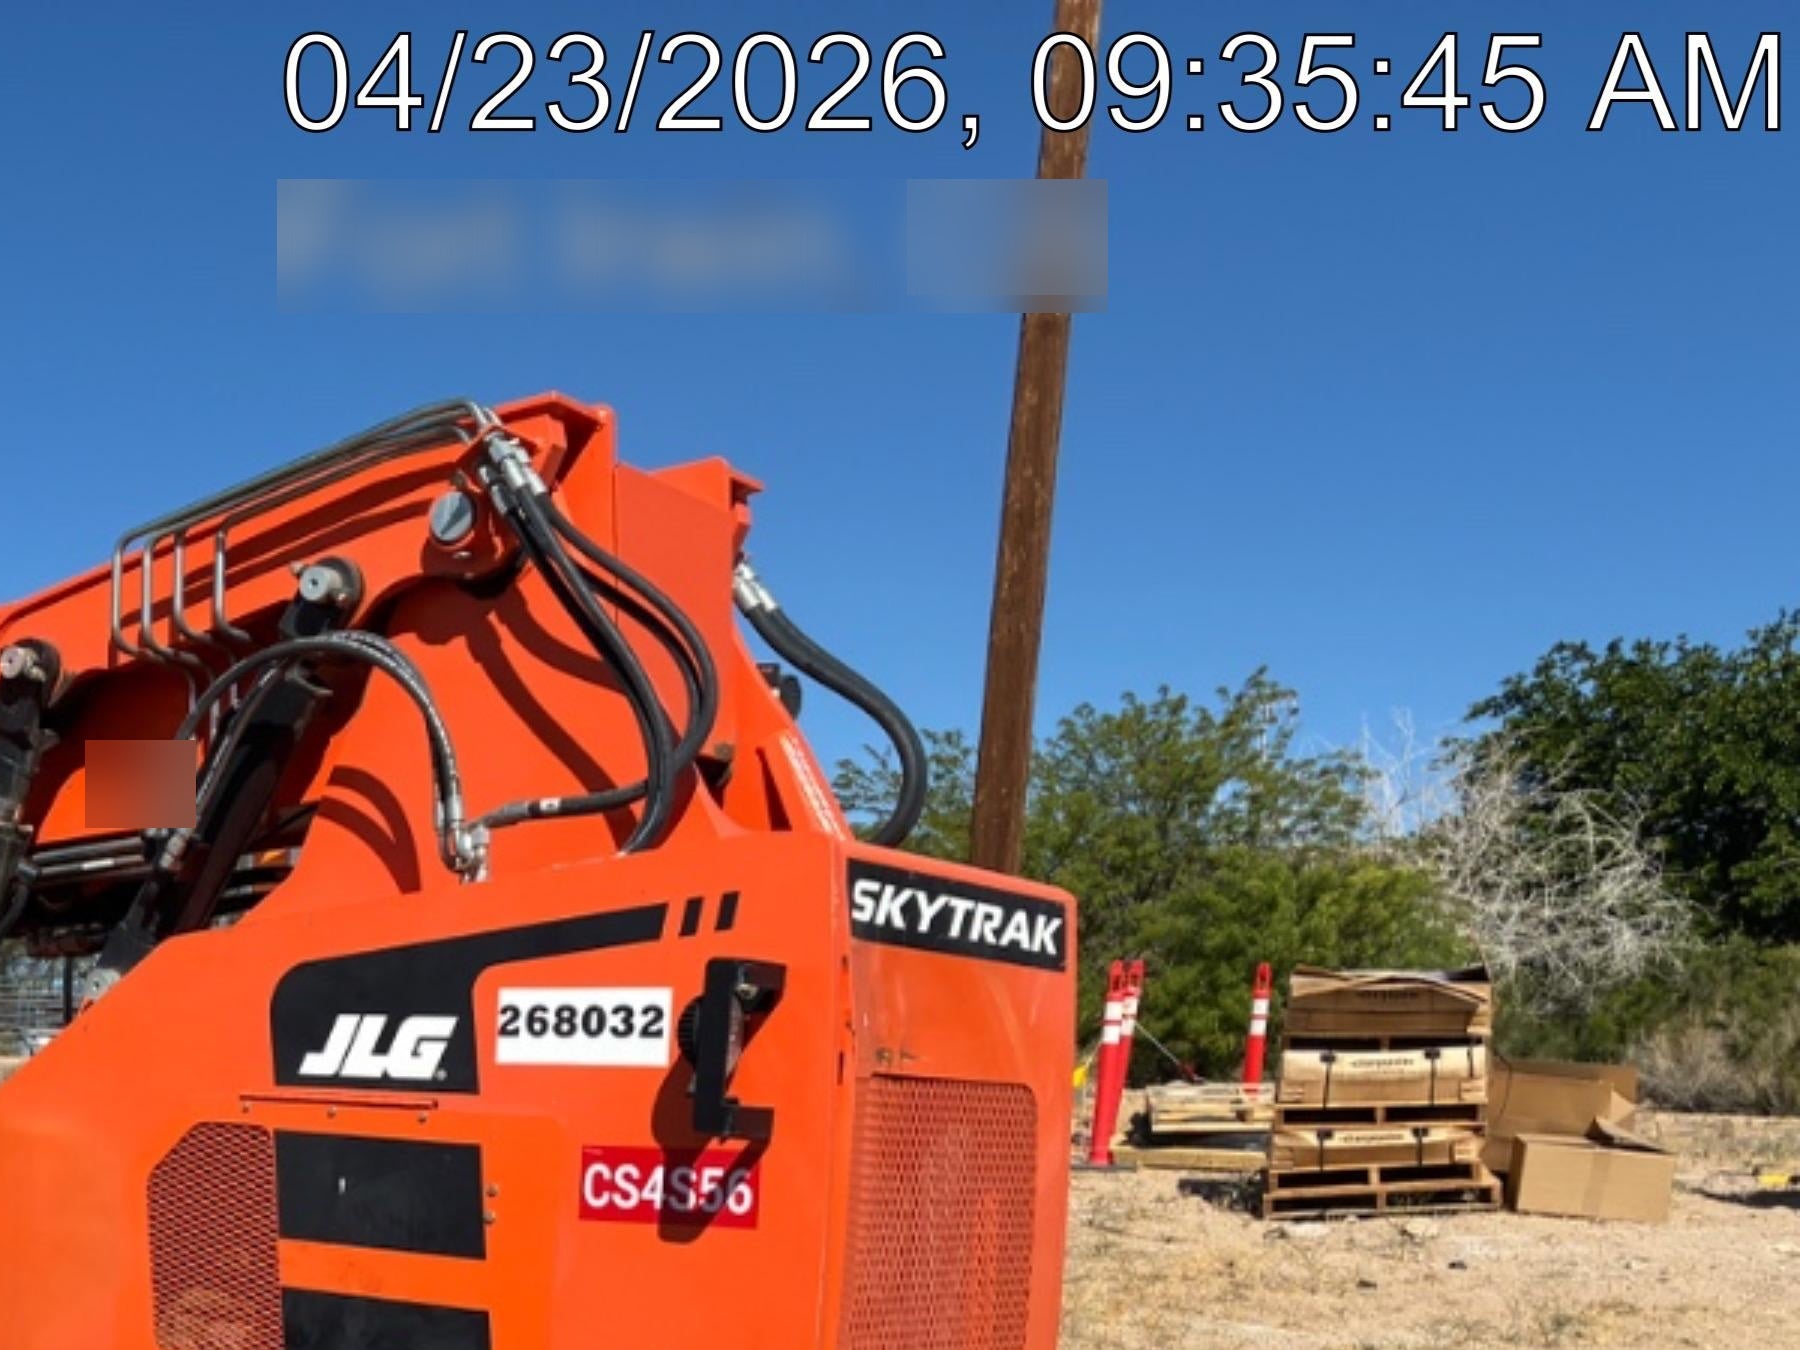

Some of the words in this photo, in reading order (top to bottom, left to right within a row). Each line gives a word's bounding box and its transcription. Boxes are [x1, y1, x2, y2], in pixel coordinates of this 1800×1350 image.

[851, 879, 1063, 956] SKYTRAK
[298, 1014, 458, 1080] JLG
[498, 1004, 665, 1039] 268032
[584, 1162, 754, 1215] CS4S56
